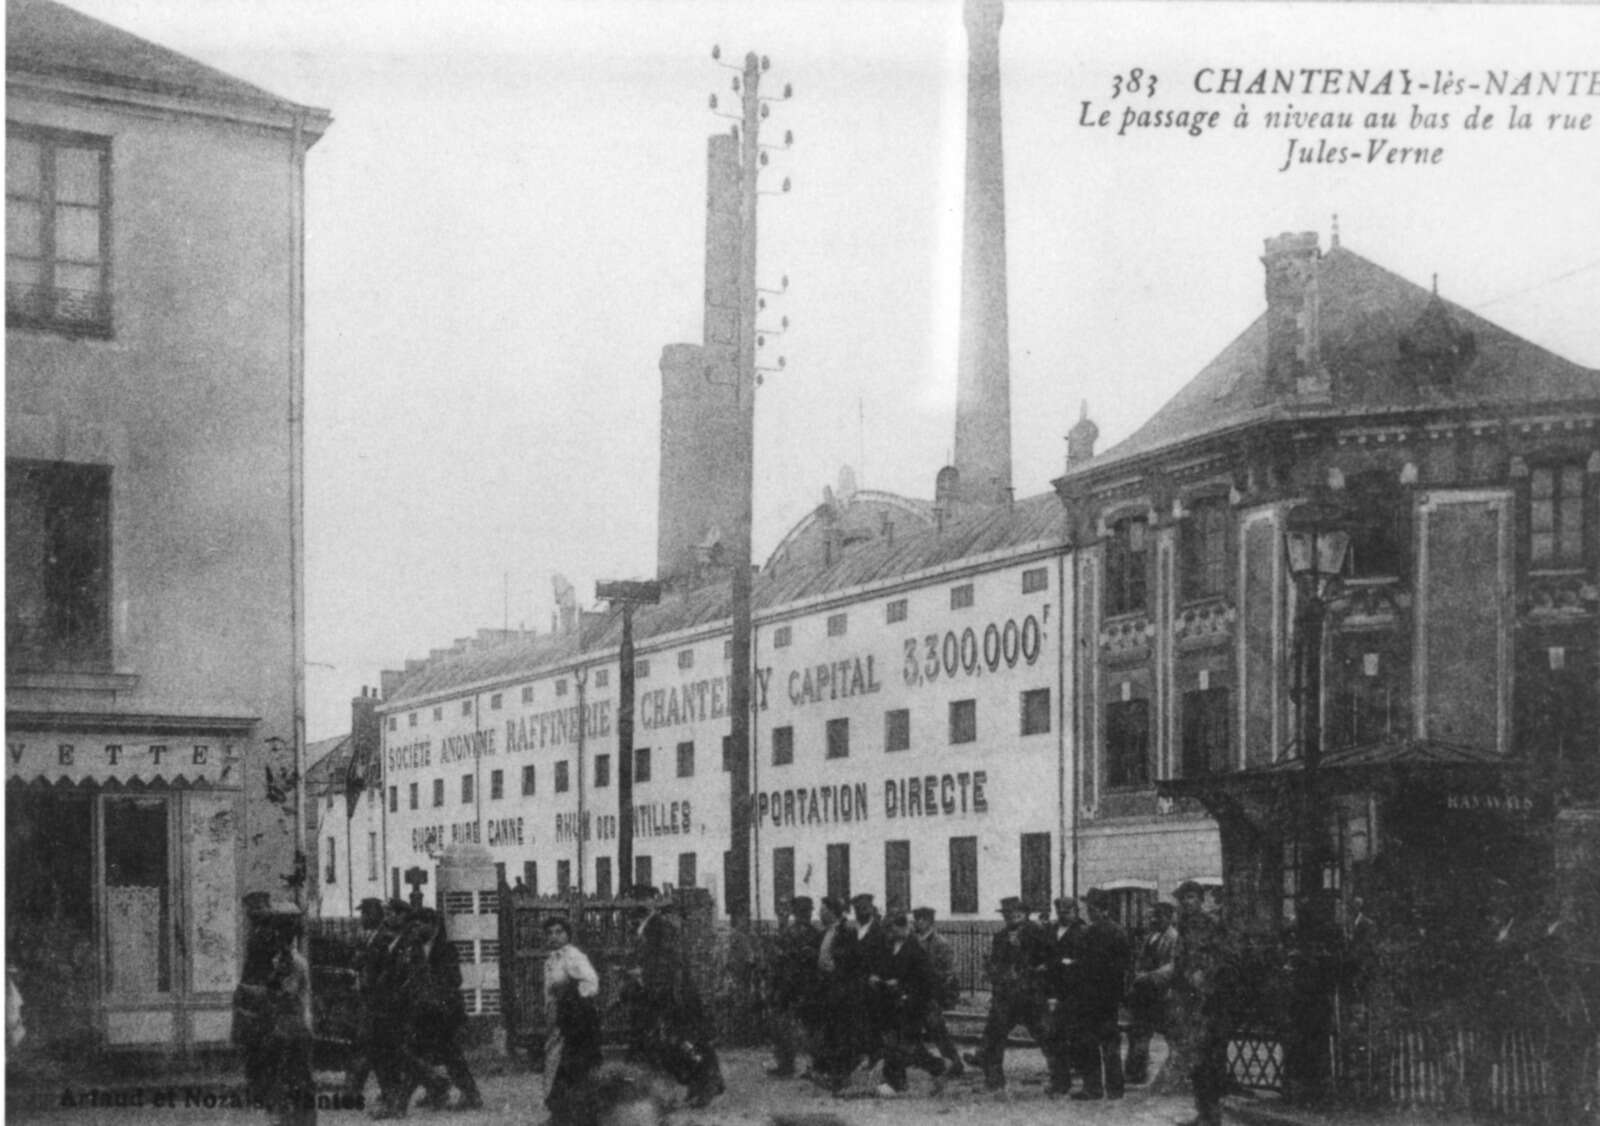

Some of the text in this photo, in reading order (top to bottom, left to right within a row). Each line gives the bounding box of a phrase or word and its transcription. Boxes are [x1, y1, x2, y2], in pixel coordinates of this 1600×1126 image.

[640, 666, 773, 731] CHANTEY
[788, 655, 881, 706] CAPITAL
[8, 744, 208, 766] VETTE
[750, 782, 868, 828] PORTATION
[885, 771, 988, 819] DIRECTE
